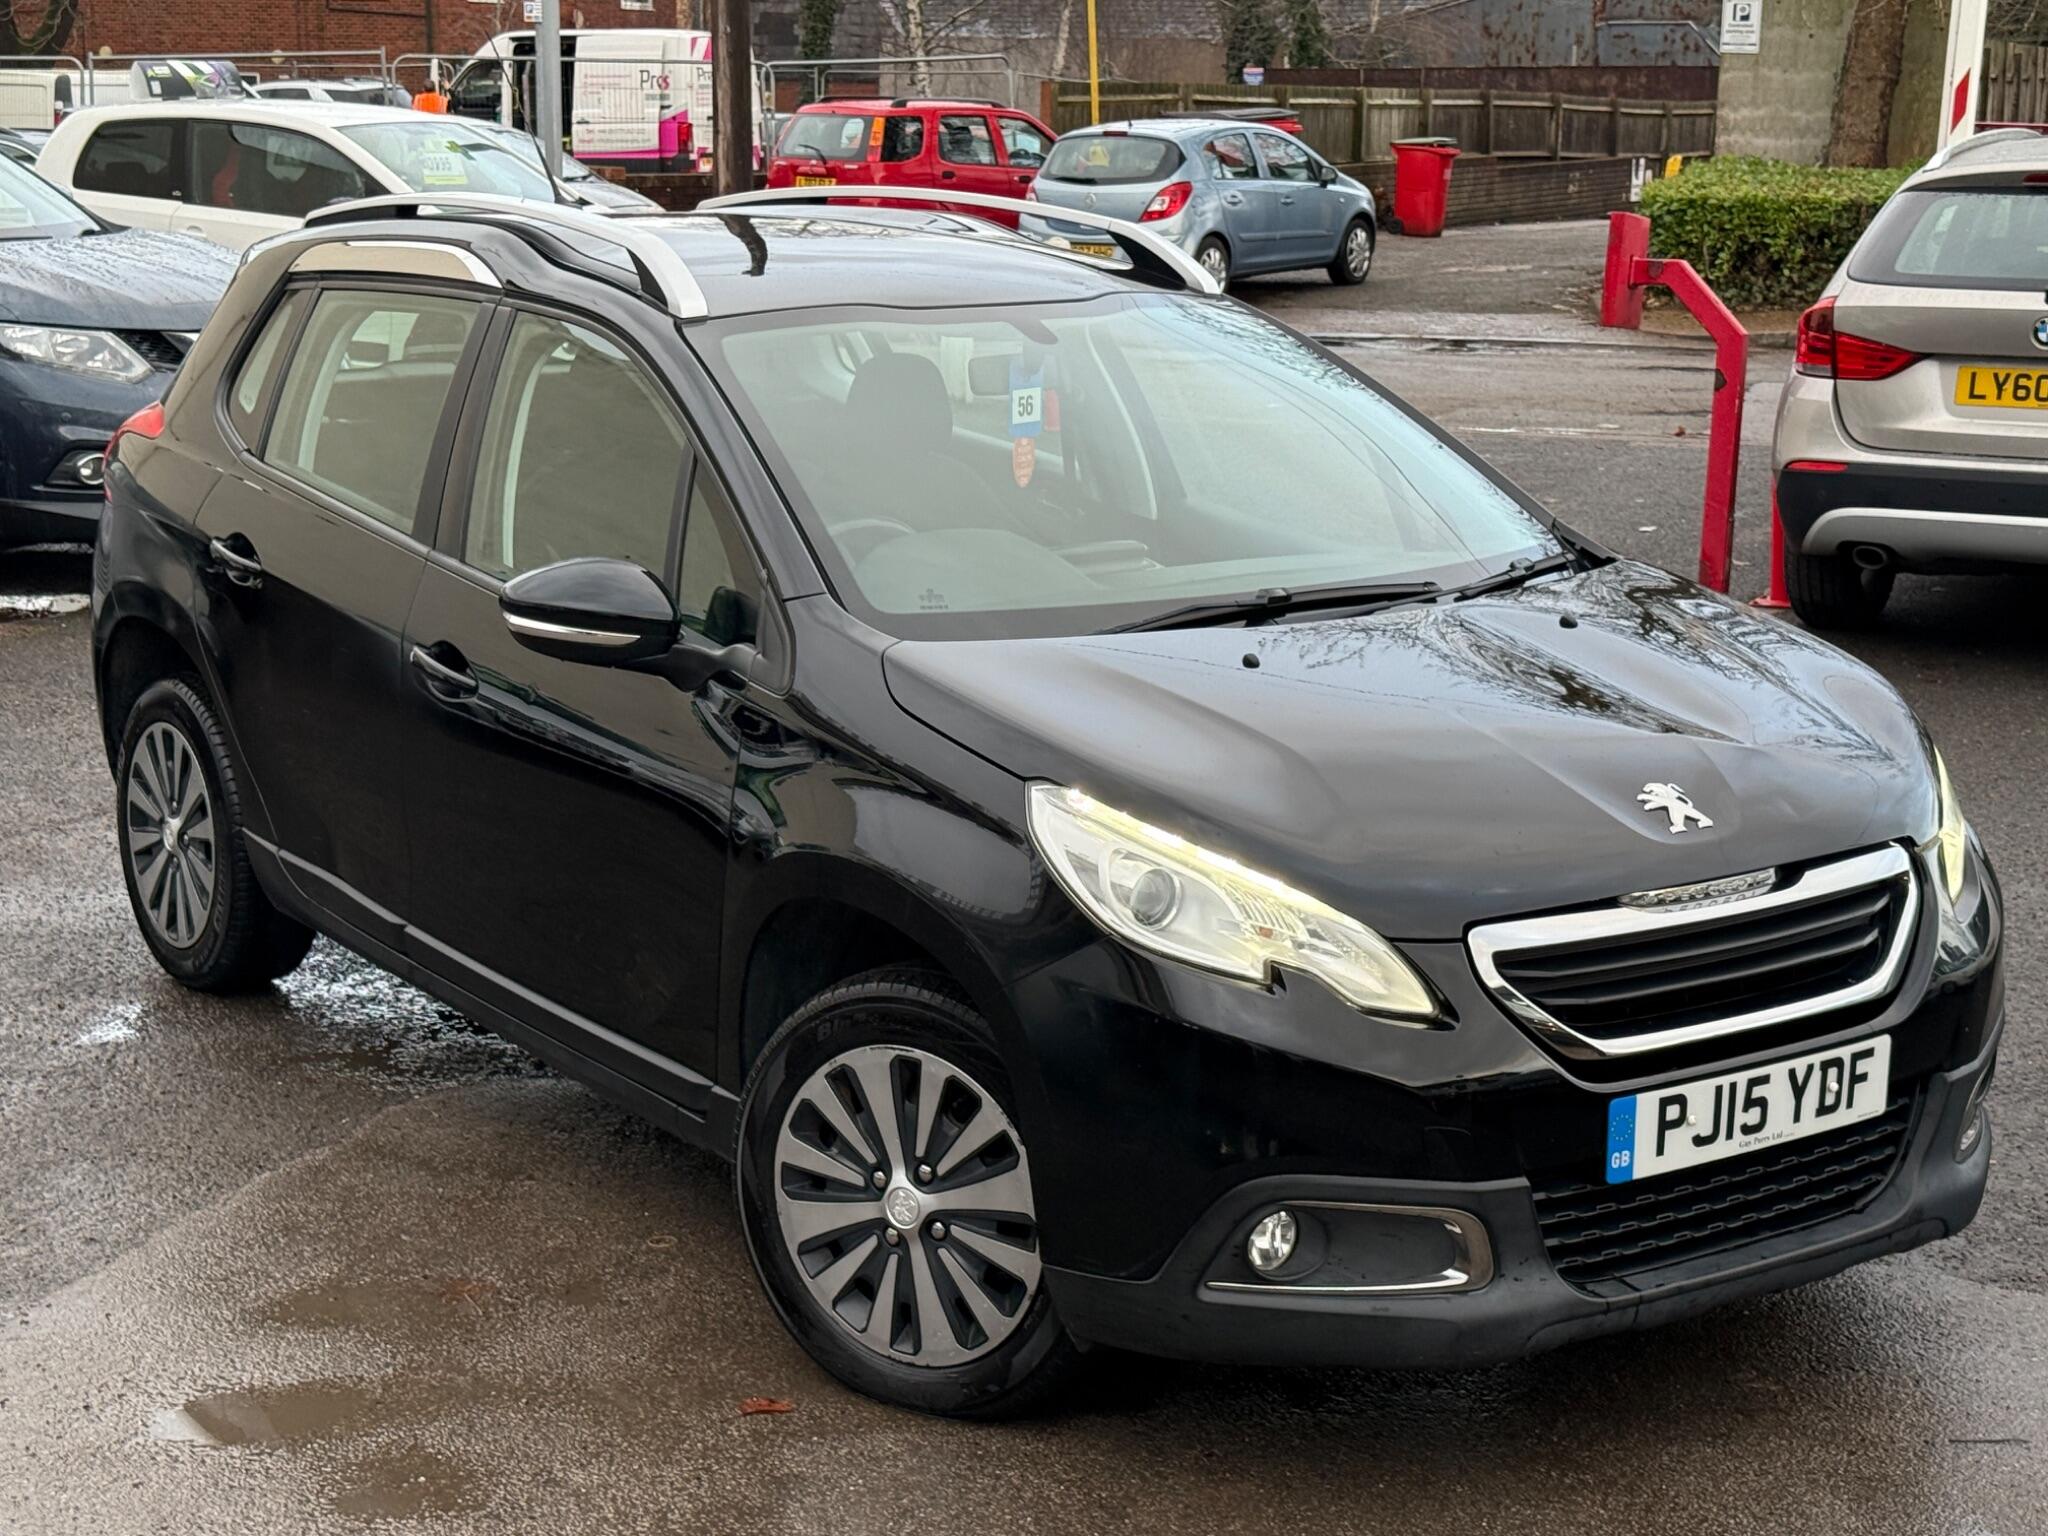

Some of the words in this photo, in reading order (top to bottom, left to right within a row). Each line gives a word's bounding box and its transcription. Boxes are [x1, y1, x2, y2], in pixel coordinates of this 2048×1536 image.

[1968, 371, 2048, 402] LY60
[1018, 395, 1034, 417] 56
[1656, 1073, 1771, 1157] PJ15
[1788, 1046, 1875, 1124] YDF
[1611, 1150, 1630, 1169] GB
